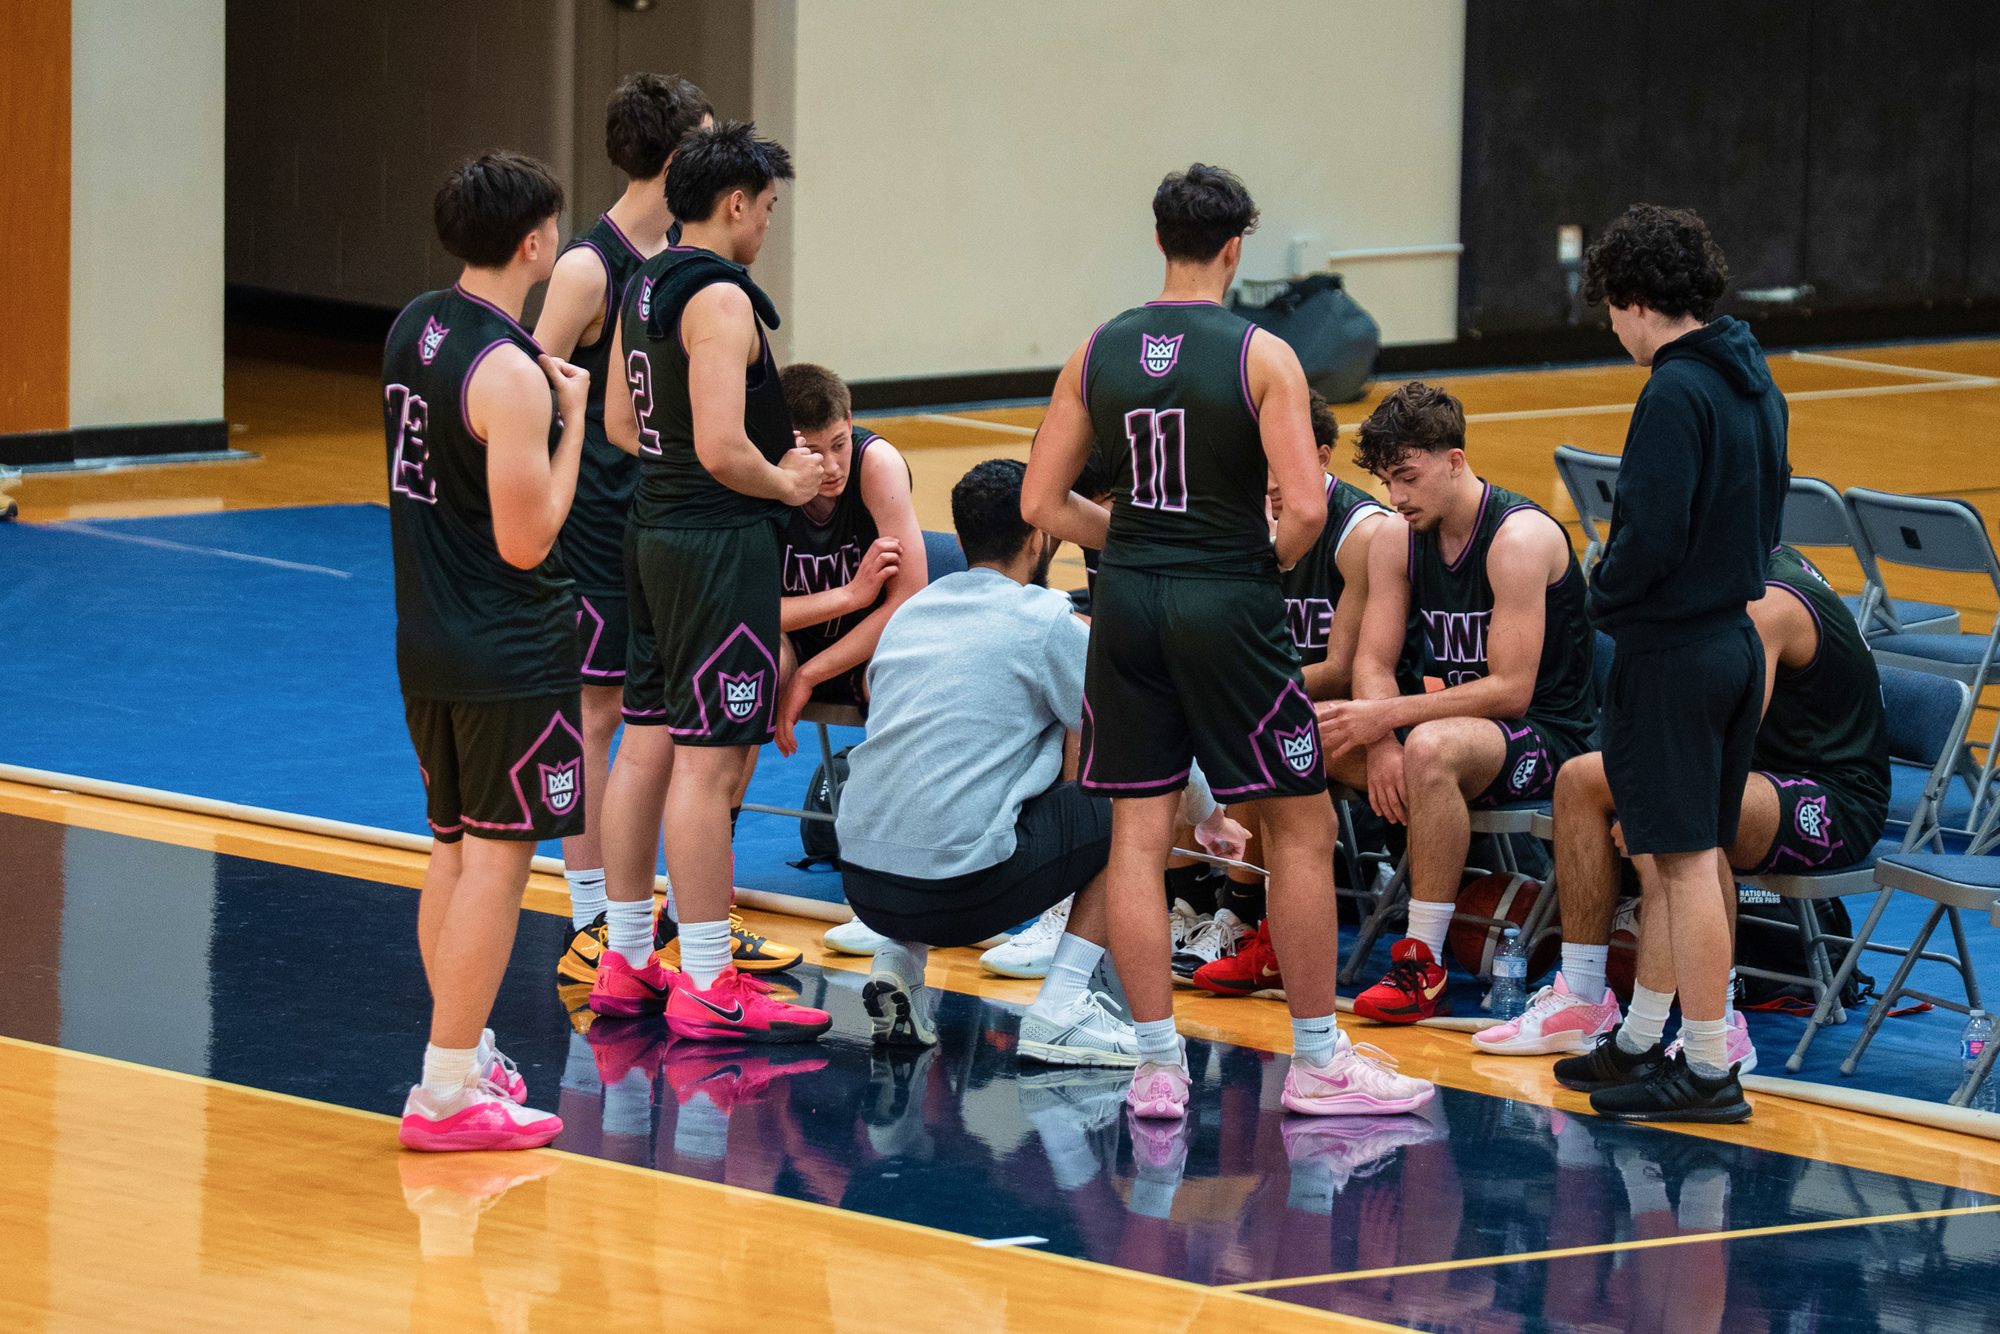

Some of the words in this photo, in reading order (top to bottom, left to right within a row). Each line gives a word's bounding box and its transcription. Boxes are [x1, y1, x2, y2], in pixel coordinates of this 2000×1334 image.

[628, 350, 663, 455] 2
[1124, 408, 1188, 512] 11
[1284, 598, 1335, 648] WE
[1740, 896, 1764, 904] PLAYER
[1764, 896, 1781, 904] PASS
